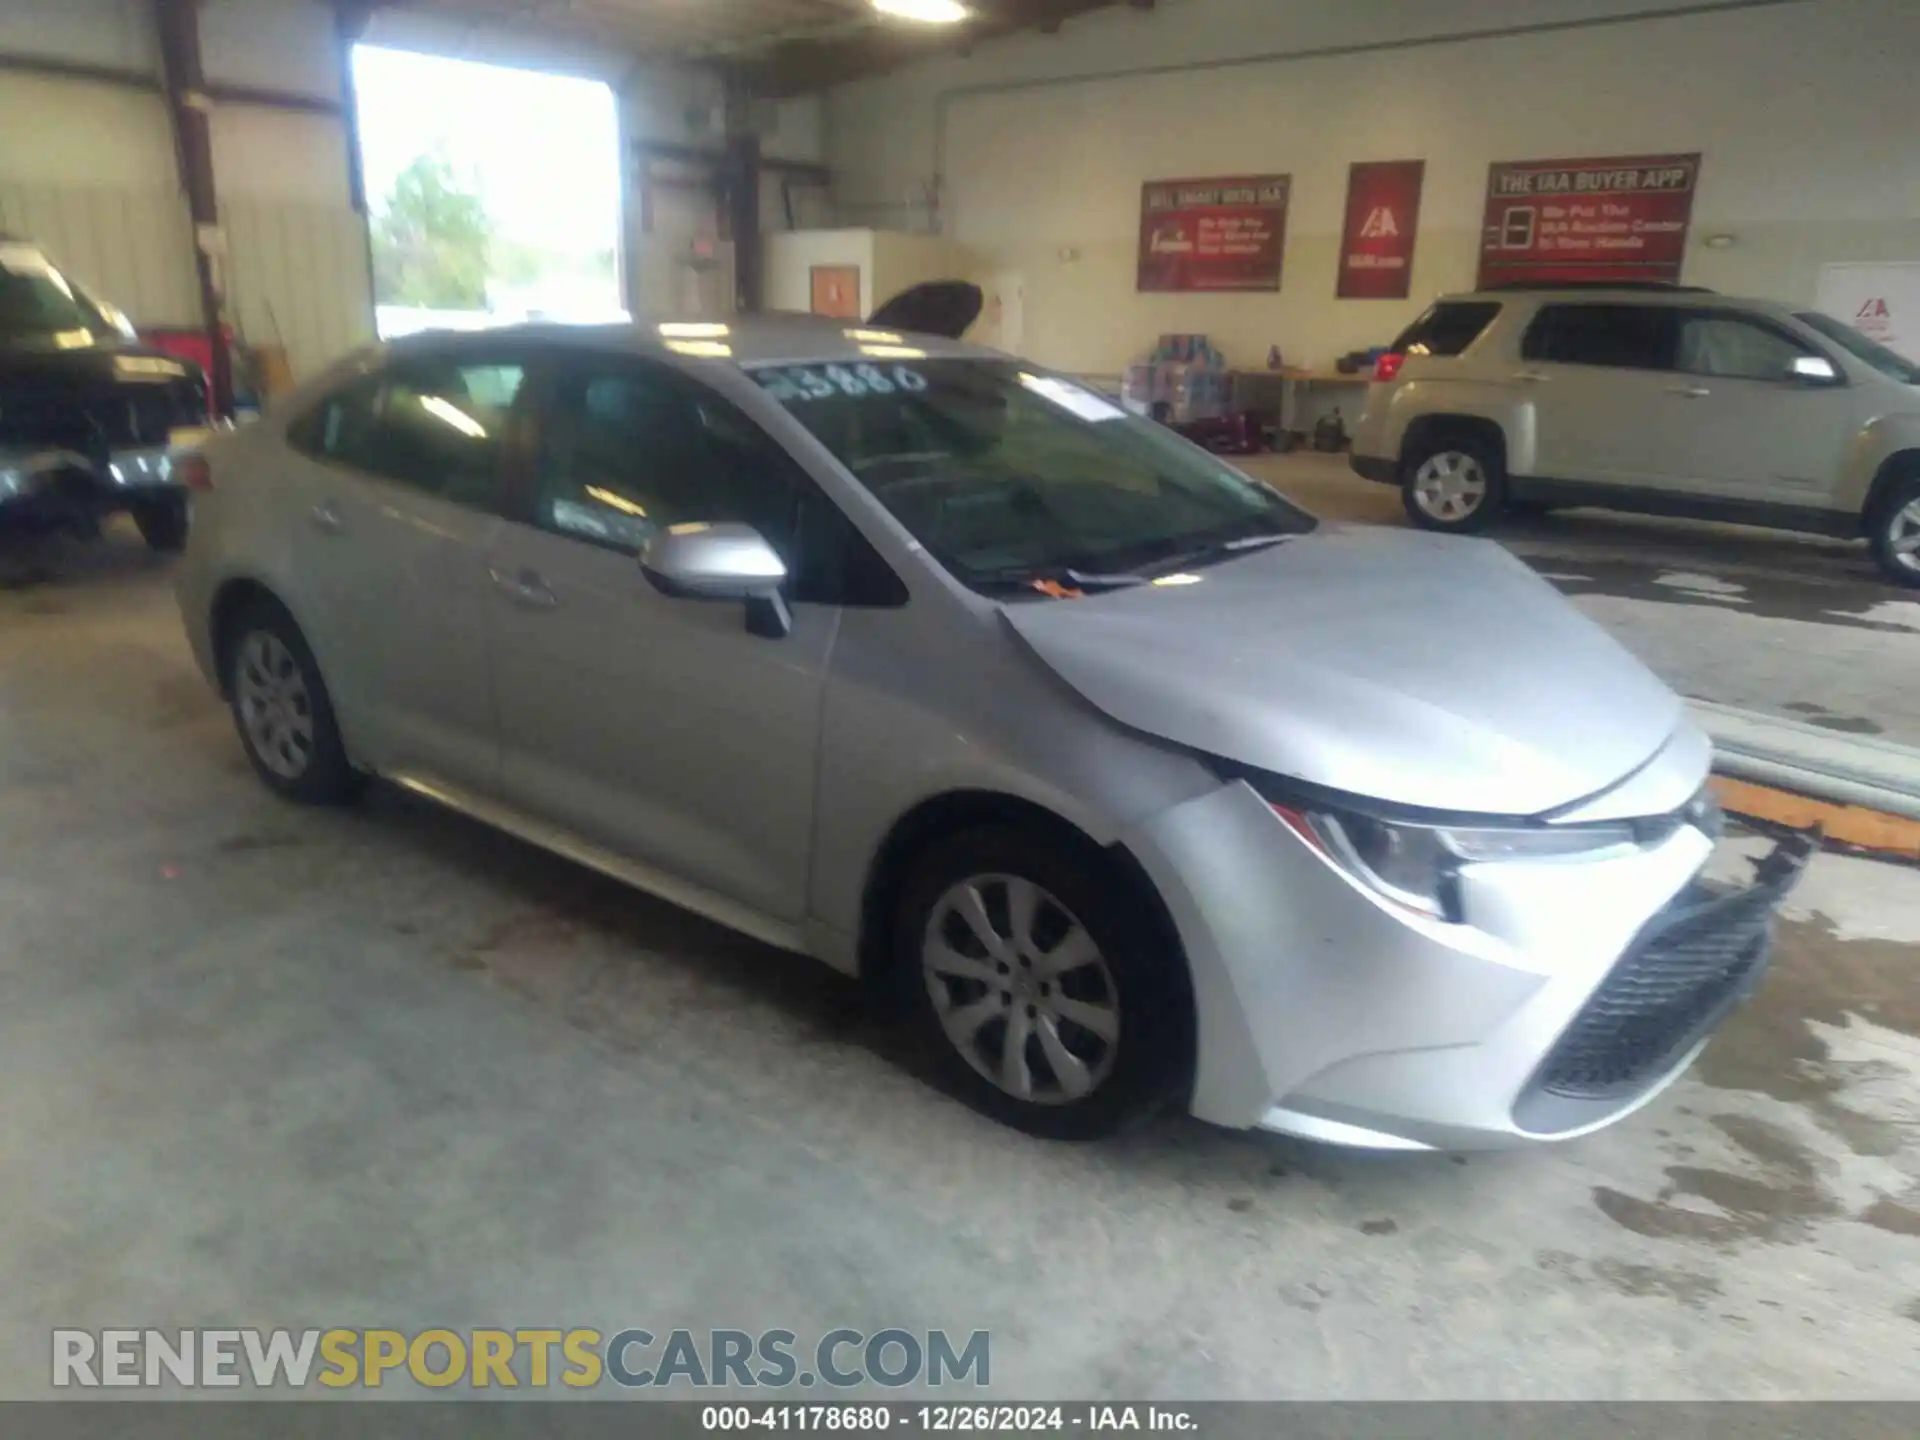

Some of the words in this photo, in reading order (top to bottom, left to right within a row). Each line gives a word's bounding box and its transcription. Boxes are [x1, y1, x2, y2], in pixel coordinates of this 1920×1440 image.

[1501, 174, 1532, 193] THE
[1536, 172, 1570, 192] IAA
[1575, 170, 1638, 190] BUYER
[1642, 169, 1684, 188] APP
